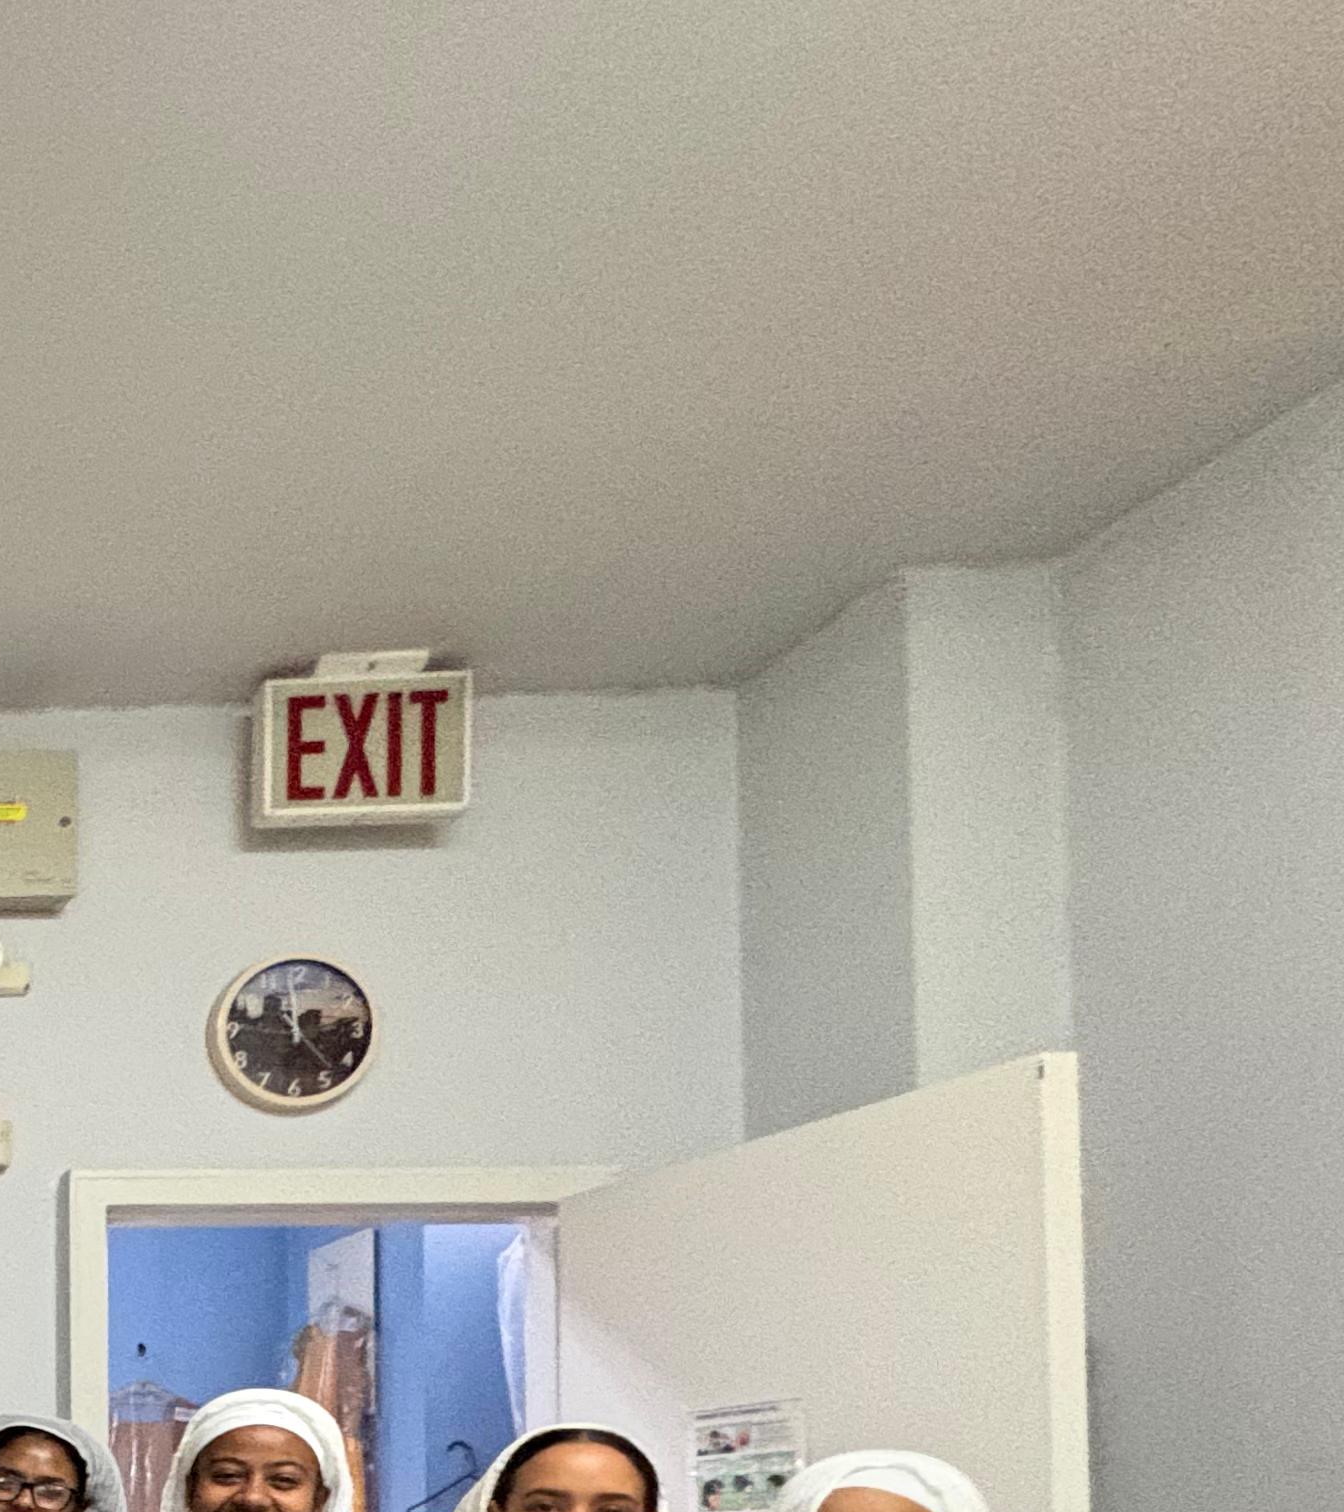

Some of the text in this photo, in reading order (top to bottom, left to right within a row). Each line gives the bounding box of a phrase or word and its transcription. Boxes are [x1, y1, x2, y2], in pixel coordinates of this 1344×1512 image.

[287, 690, 449, 801] EXIT
[227, 1021, 240, 1040] 9
[351, 1021, 365, 1039] 3
[234, 1051, 248, 1069] 8
[340, 1051, 355, 1067] 4
[257, 1072, 271, 1088] 7
[287, 1078, 302, 1097] 6
[317, 1070, 332, 1089] 5
